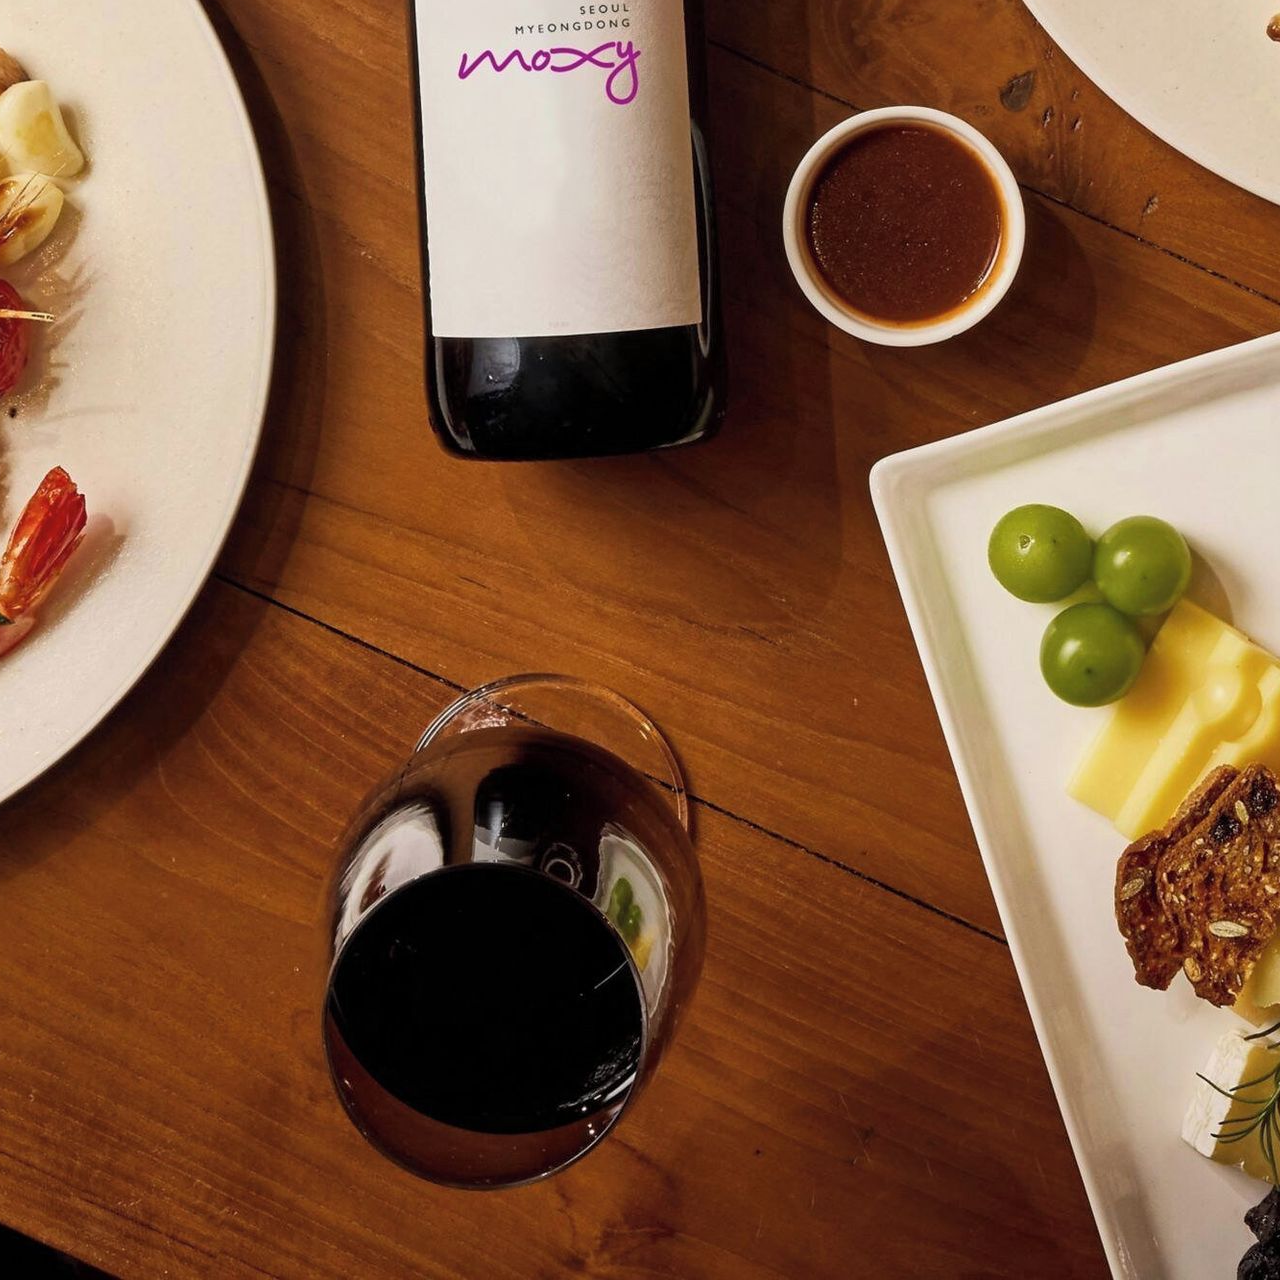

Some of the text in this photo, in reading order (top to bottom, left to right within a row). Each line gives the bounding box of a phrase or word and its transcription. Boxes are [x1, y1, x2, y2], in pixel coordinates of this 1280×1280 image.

[579, 3, 630, 15] SEOUL
[515, 18, 631, 35] MYEONGDONG
[458, 40, 641, 105] moxy
